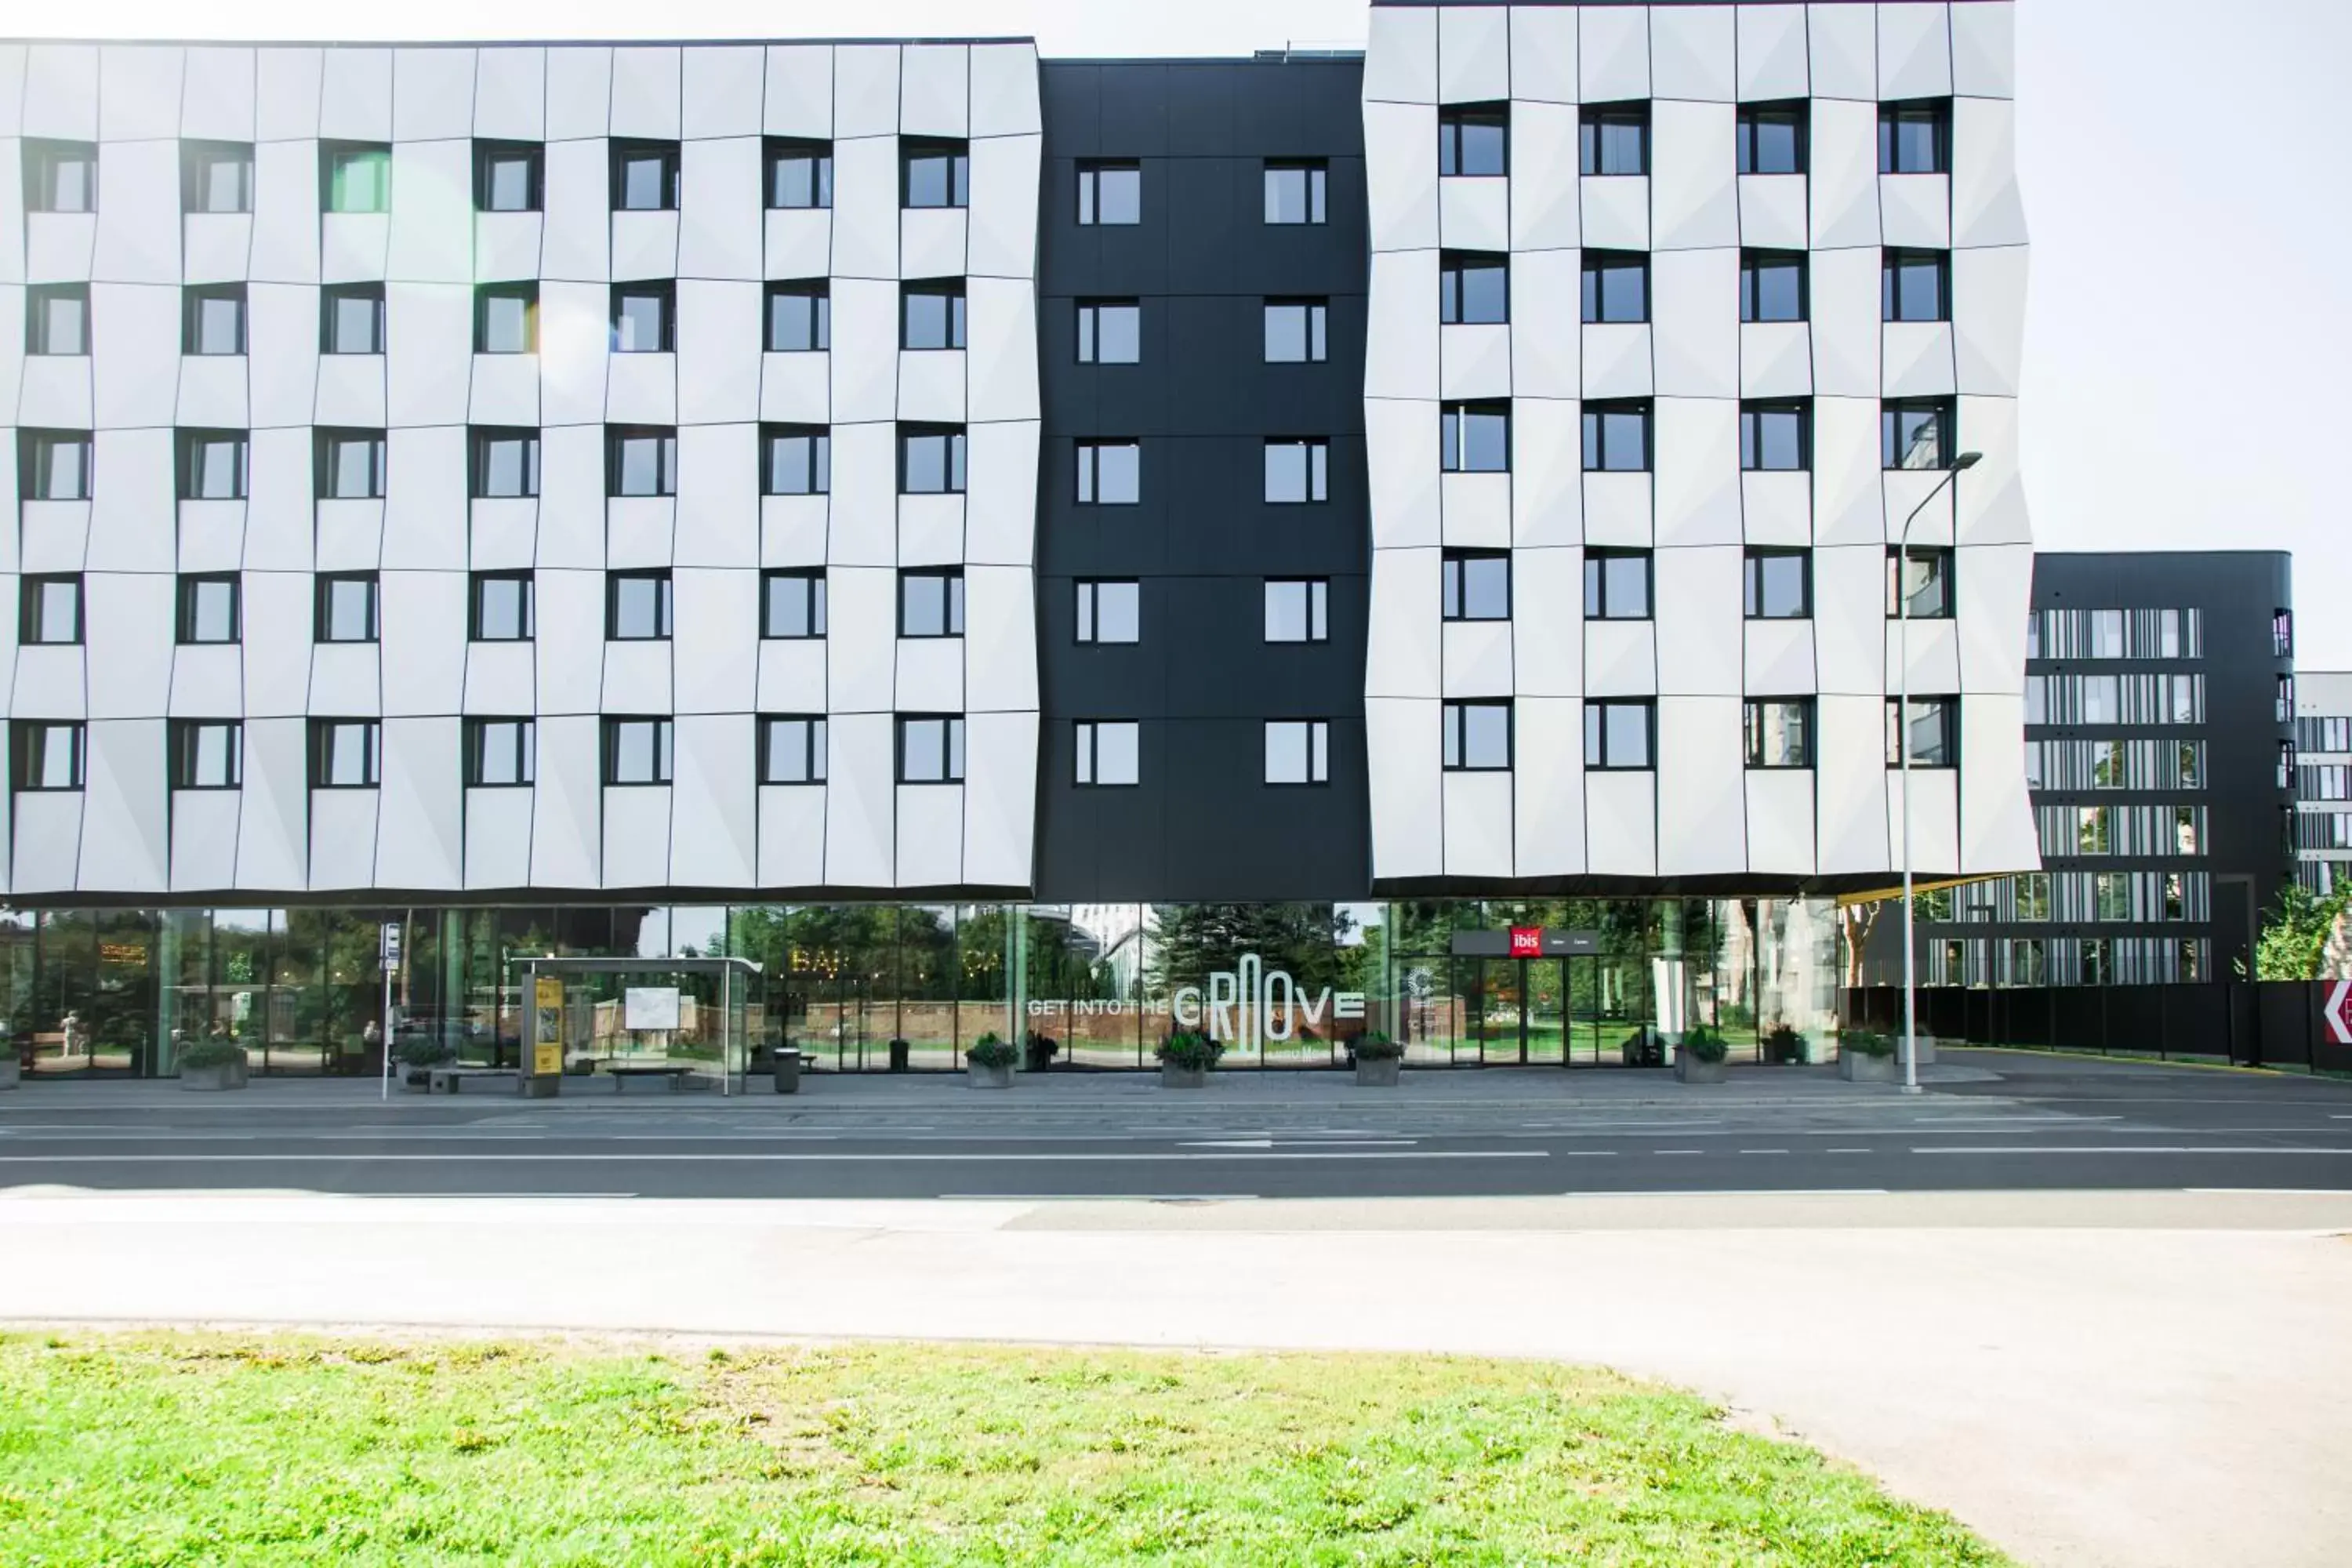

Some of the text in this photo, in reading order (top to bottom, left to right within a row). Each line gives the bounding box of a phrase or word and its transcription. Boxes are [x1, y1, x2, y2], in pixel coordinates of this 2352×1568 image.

[1513, 934, 1538, 948] ibis
[1028, 999, 1069, 1015] GET
[1073, 999, 1122, 1016] INTO
[1124, 999, 1170, 1015] THE
[1173, 953, 1365, 1055] GROOVE
